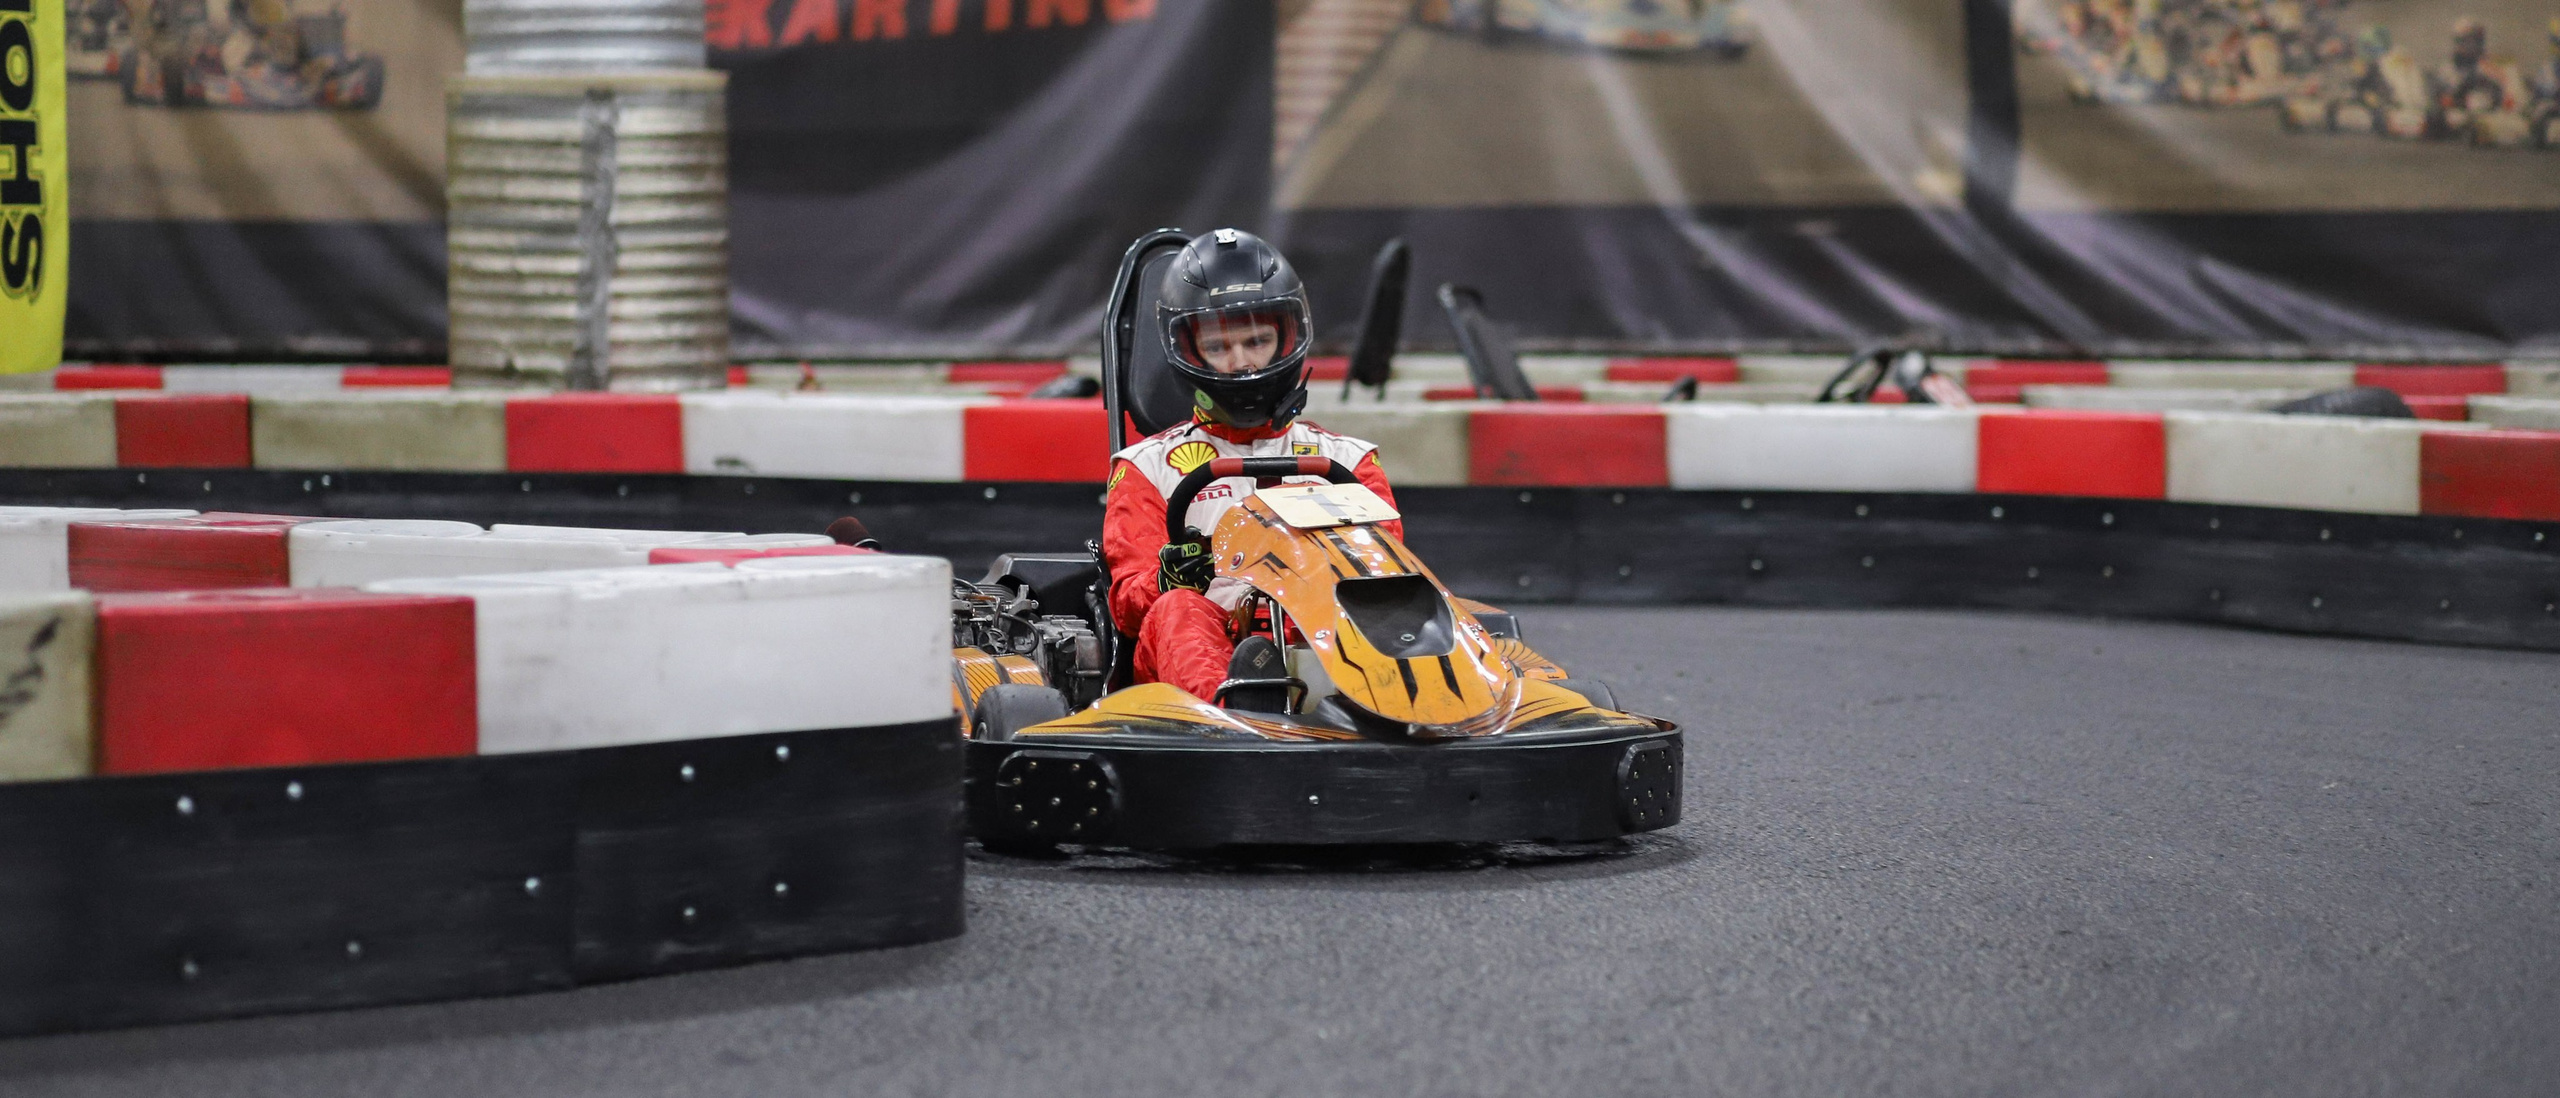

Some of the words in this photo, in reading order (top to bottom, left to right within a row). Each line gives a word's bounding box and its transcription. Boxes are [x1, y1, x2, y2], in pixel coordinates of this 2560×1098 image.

[0, 0, 44, 300] SHO
[1209, 283, 1263, 297] LS2
[1188, 484, 1233, 503] ELLI
